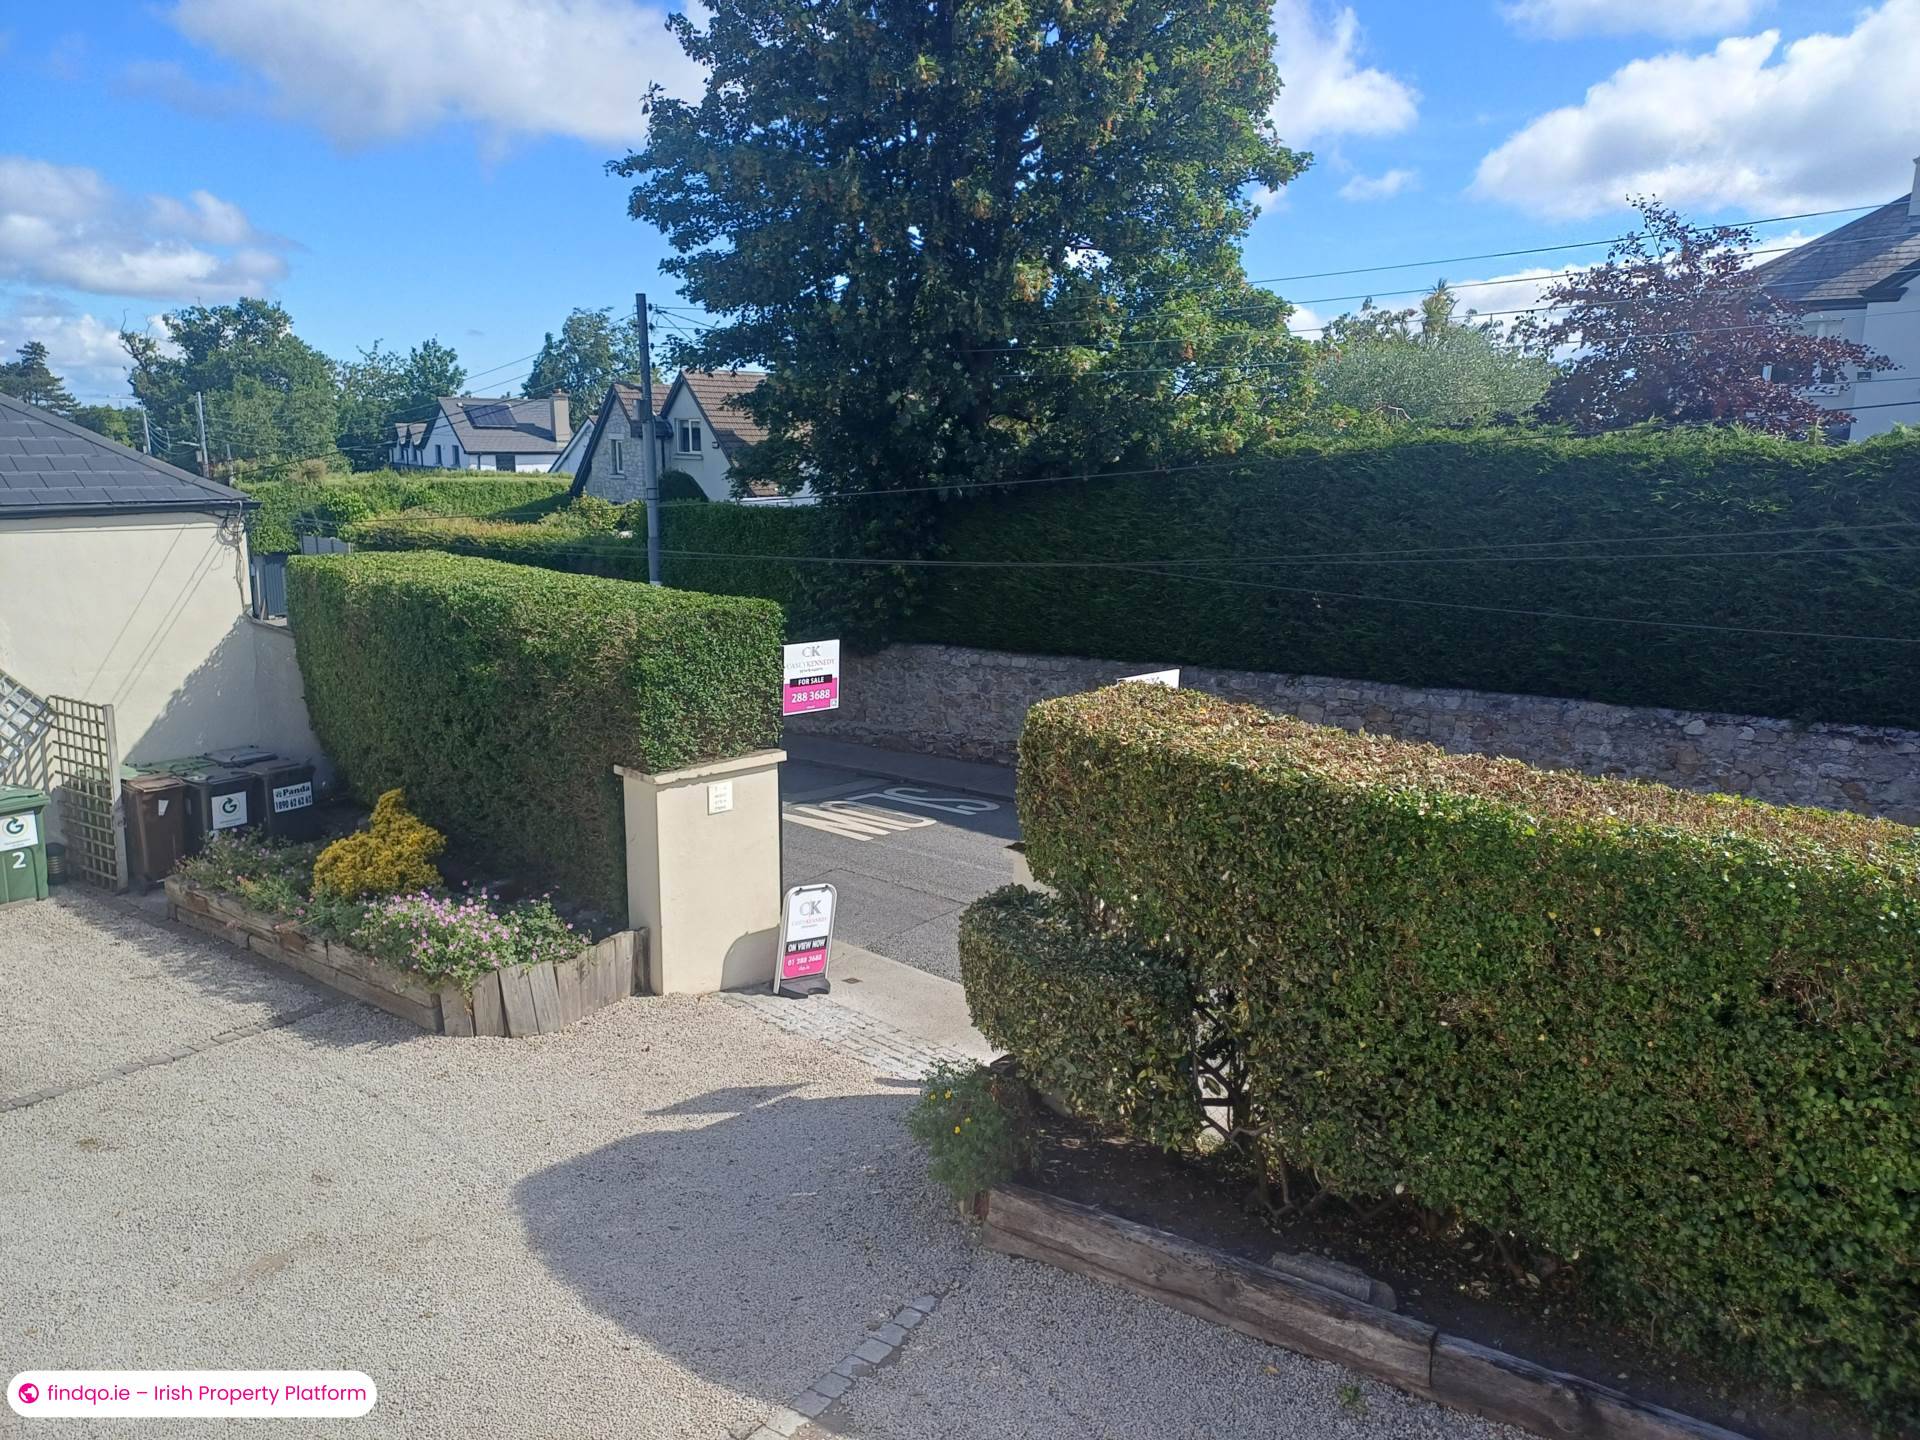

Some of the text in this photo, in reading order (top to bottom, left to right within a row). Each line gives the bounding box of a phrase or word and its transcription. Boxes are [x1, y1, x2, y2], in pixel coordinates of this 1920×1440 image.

[802, 645, 821, 657] CK
[798, 676, 825, 686] FOR SALE
[791, 689, 831, 703] 288 3688
[282, 784, 311, 797] Panda
[12, 851, 26, 869] 2
[800, 900, 821, 916] CK
[788, 938, 826, 952] ON VIEW NOW
